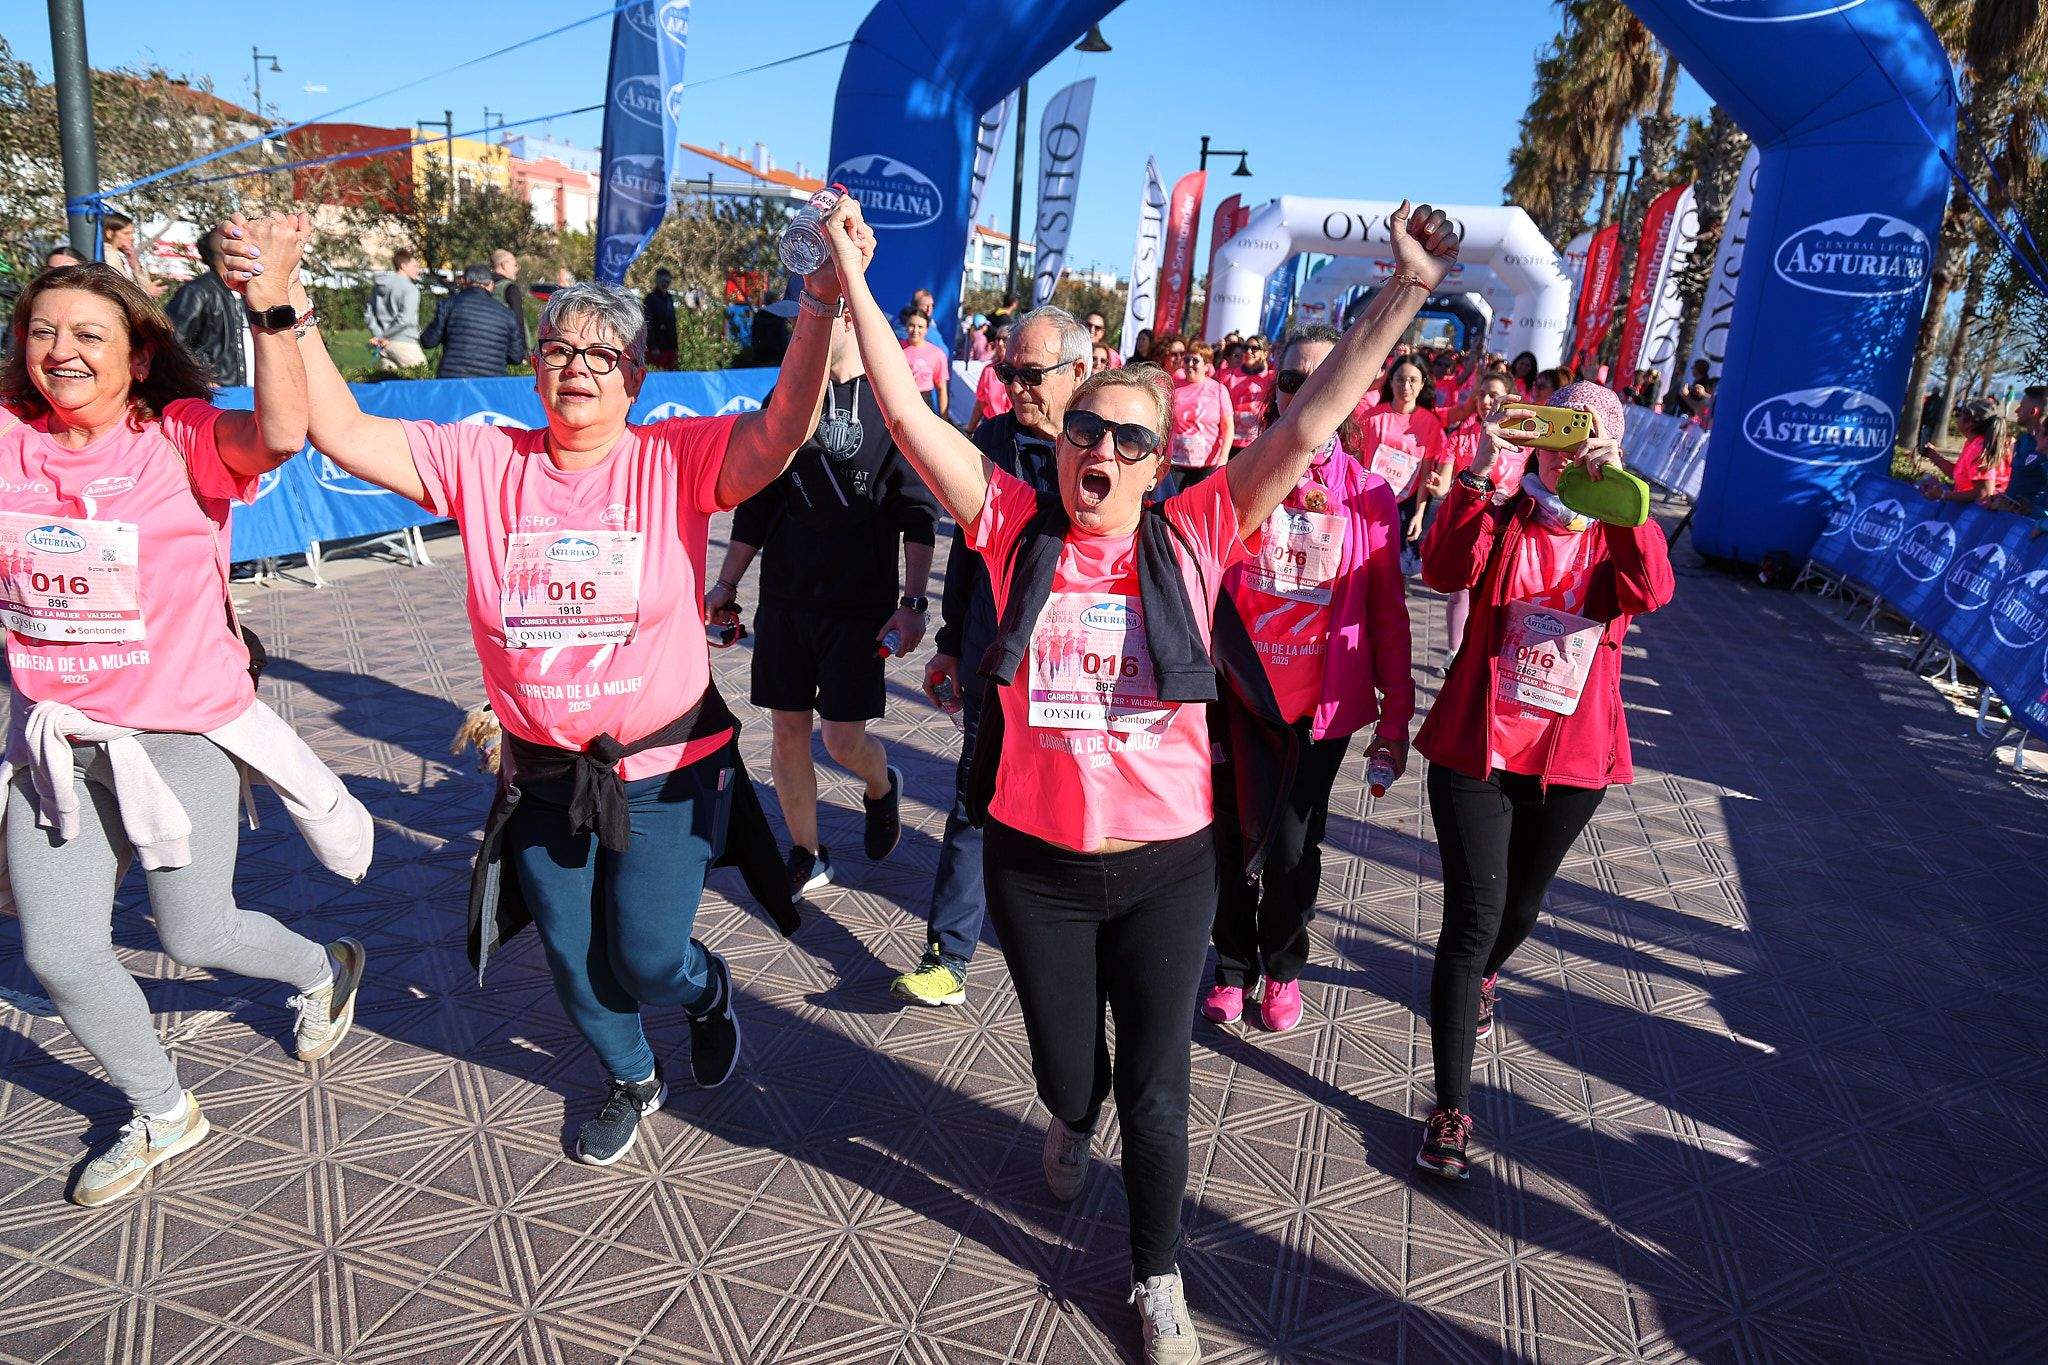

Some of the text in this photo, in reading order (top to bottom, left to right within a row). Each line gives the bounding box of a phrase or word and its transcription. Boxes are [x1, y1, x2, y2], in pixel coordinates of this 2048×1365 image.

[1037, 122, 1081, 304] OYSHO
[1815, 240, 1874, 250] CENTRAL
[1784, 241, 1924, 278] ASTURIANA
[1752, 410, 1888, 448] ASTURIANA
[29, 533, 83, 549] ASTURIANA
[549, 546, 597, 557] ASTURIANA
[1273, 546, 1307, 566] 016
[31, 572, 90, 595] 016
[1246, 576, 1274, 589] OYSHO
[547, 581, 598, 601] 016
[48, 598, 69, 609] 896
[557, 606, 583, 615] 1918
[10, 615, 47, 633] OYSHO
[519, 617, 549, 627] CARRERA
[1084, 611, 1139, 628] ASTURIANA
[1524, 617, 1563, 634] ASTURIANA
[77, 627, 127, 635] Santander
[519, 630, 563, 641] OYSHO
[1271, 643, 1285, 655] DE
[1286, 645, 1298, 656] LA
[1515, 646, 1556, 669] 016
[8, 649, 151, 673] ARRERA DE LA MUJER
[1082, 652, 1139, 678] 016
[1271, 655, 1289, 666] 2025
[565, 684, 583, 699] DE
[585, 681, 601, 698] LA
[1095, 681, 1117, 693] 895
[567, 700, 592, 713] 2025
[1047, 692, 1079, 702] CARRERA
[1080, 694, 1091, 702] DE
[1101, 695, 1125, 705] MUJER
[1130, 699, 1164, 709] VALENCIA
[1530, 692, 1564, 707] Santander
[1043, 708, 1092, 721] OYSHO
[1119, 715, 1165, 726] Santander
[1087, 735, 1107, 753] DE
